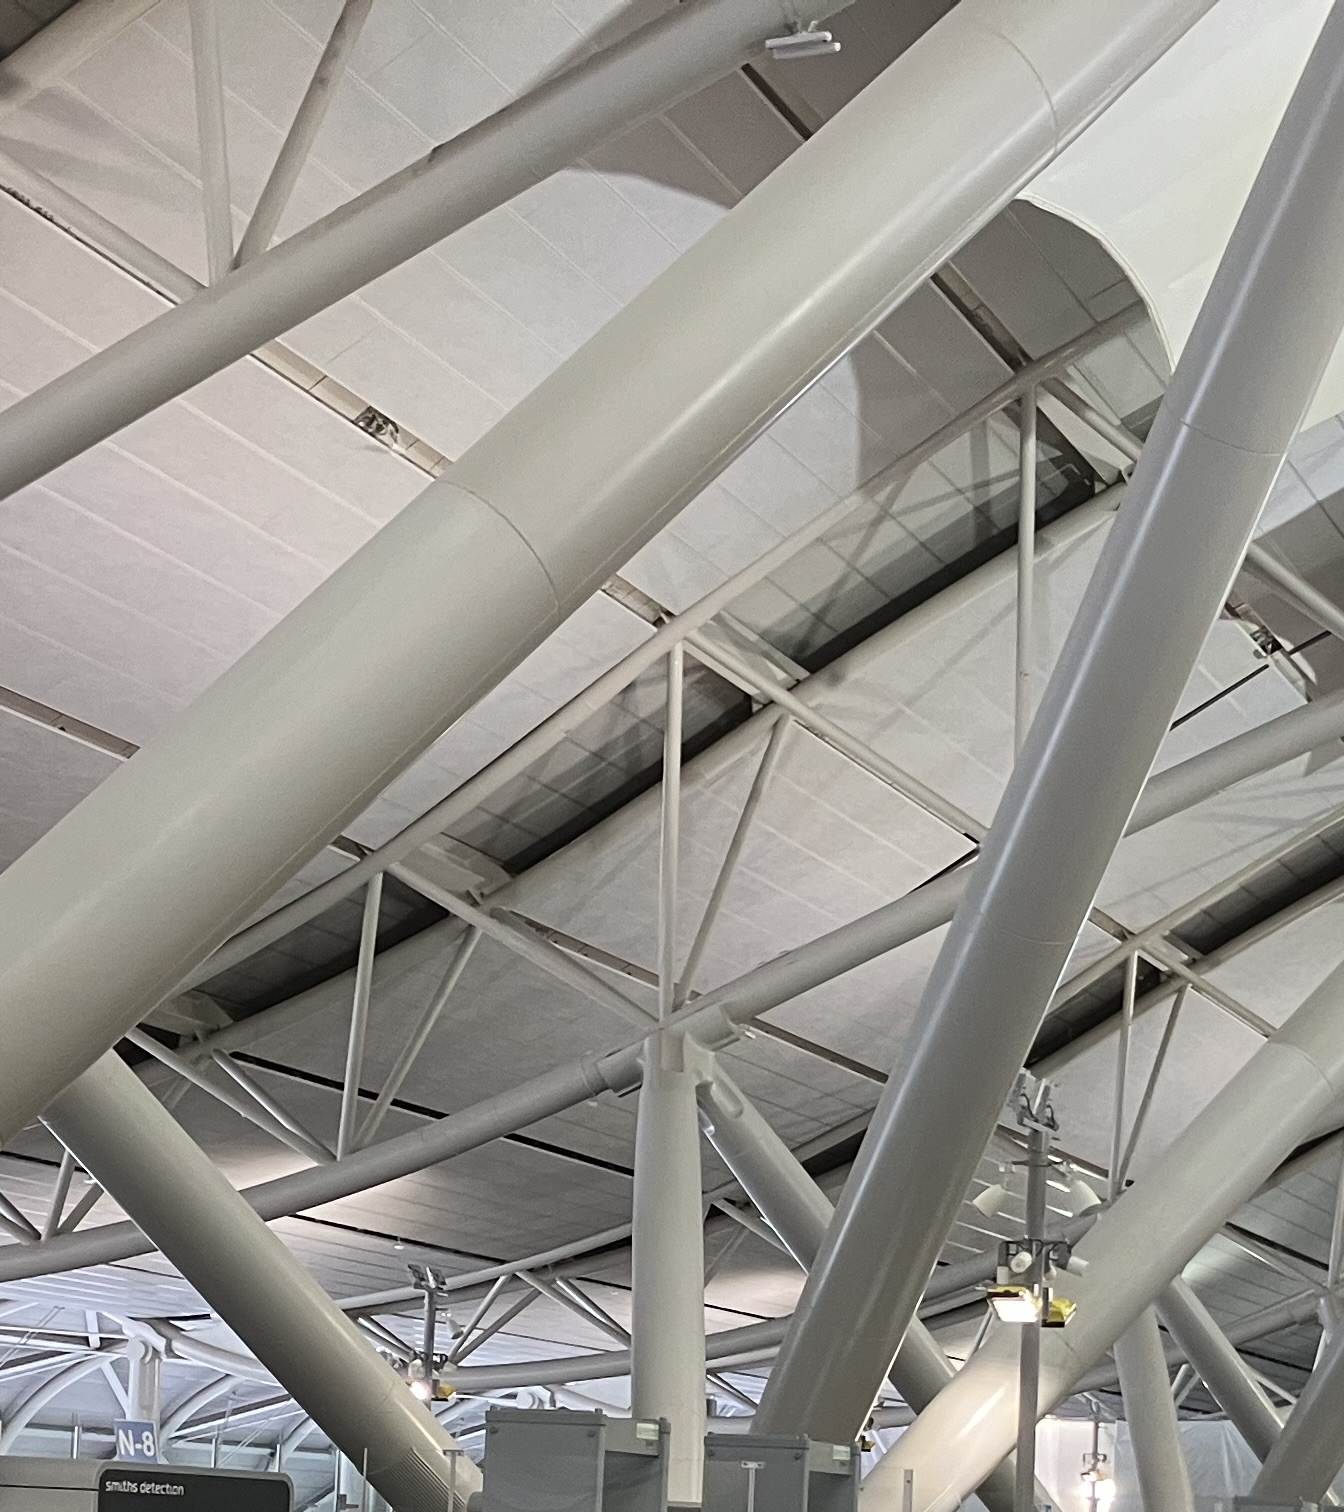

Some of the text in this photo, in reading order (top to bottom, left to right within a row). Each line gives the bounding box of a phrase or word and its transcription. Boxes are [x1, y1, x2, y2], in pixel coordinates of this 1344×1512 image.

[118, 1428, 155, 1458] N-8
[105, 1479, 185, 1496] smiths detection
